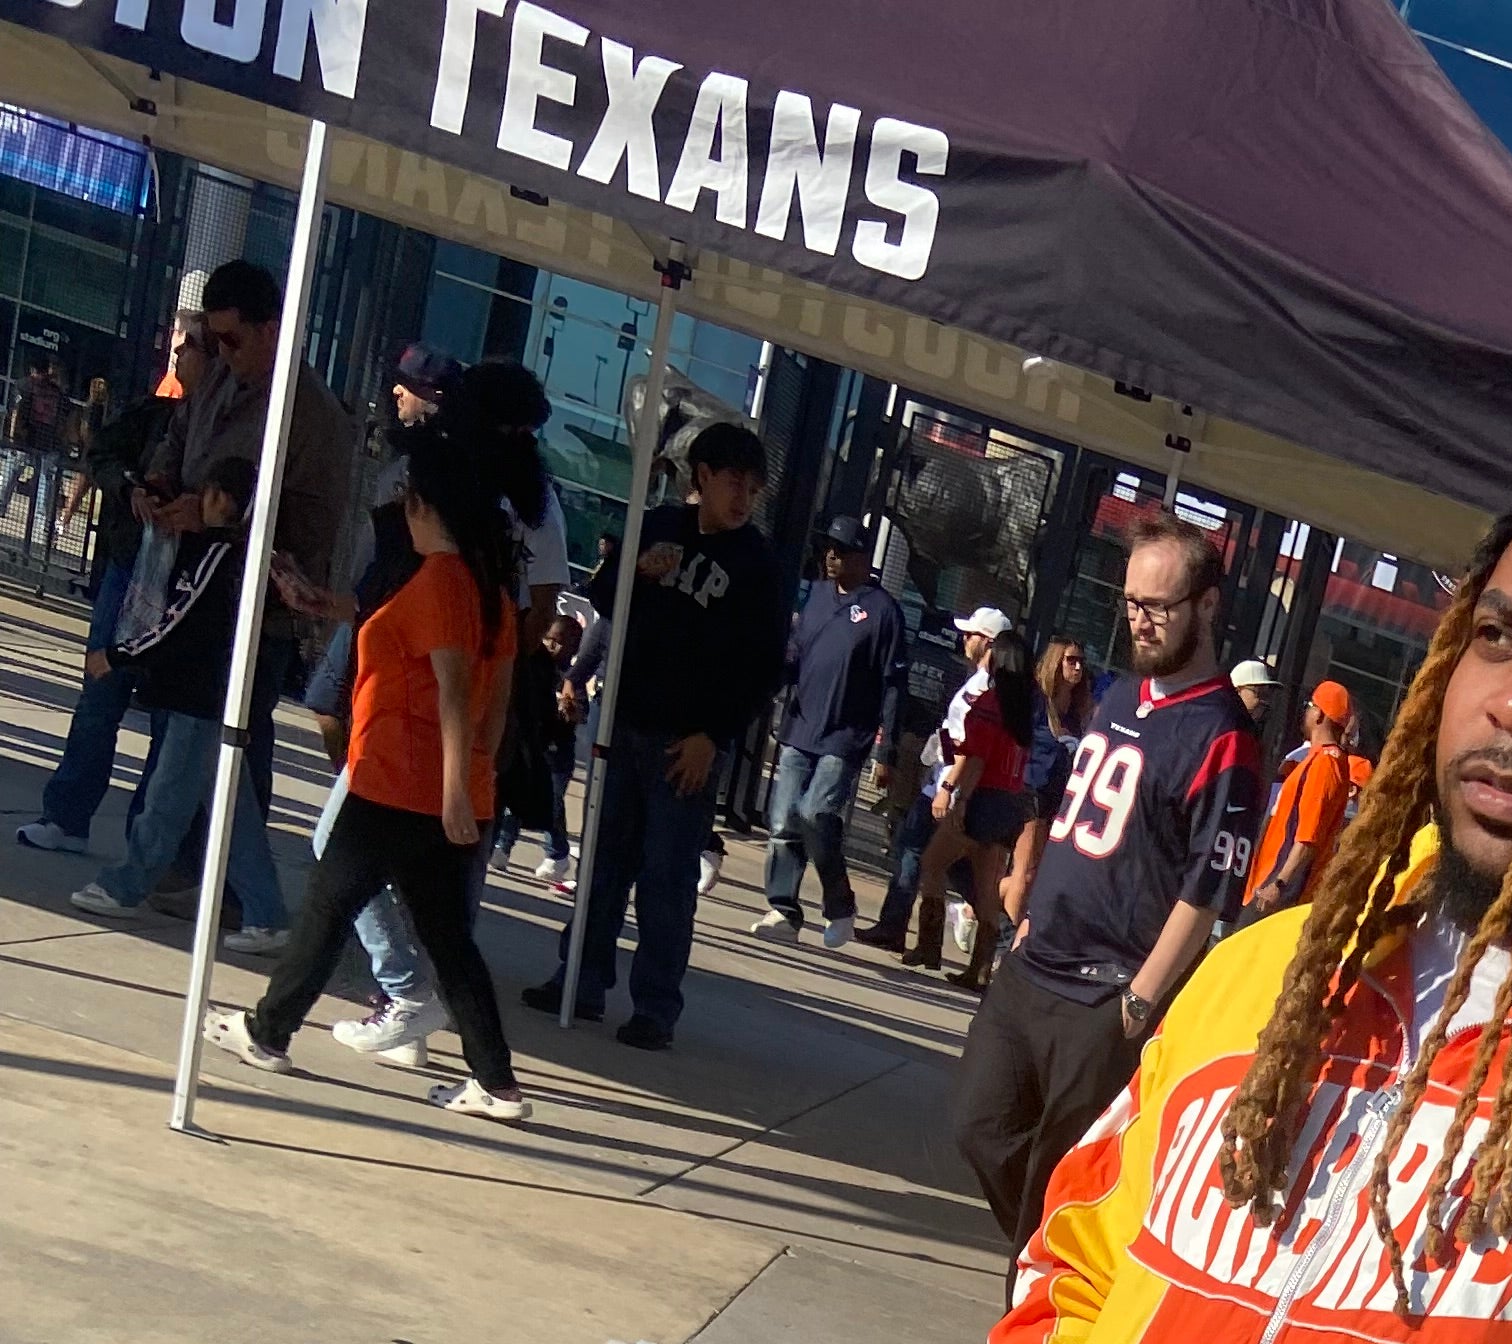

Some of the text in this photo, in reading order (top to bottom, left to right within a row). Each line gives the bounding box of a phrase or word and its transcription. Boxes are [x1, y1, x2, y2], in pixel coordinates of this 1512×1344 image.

[430, 0, 949, 281] TEXANS
[20, 332, 59, 352] stadium
[1049, 730, 1144, 859] 99
[1210, 830, 1250, 878] 99
